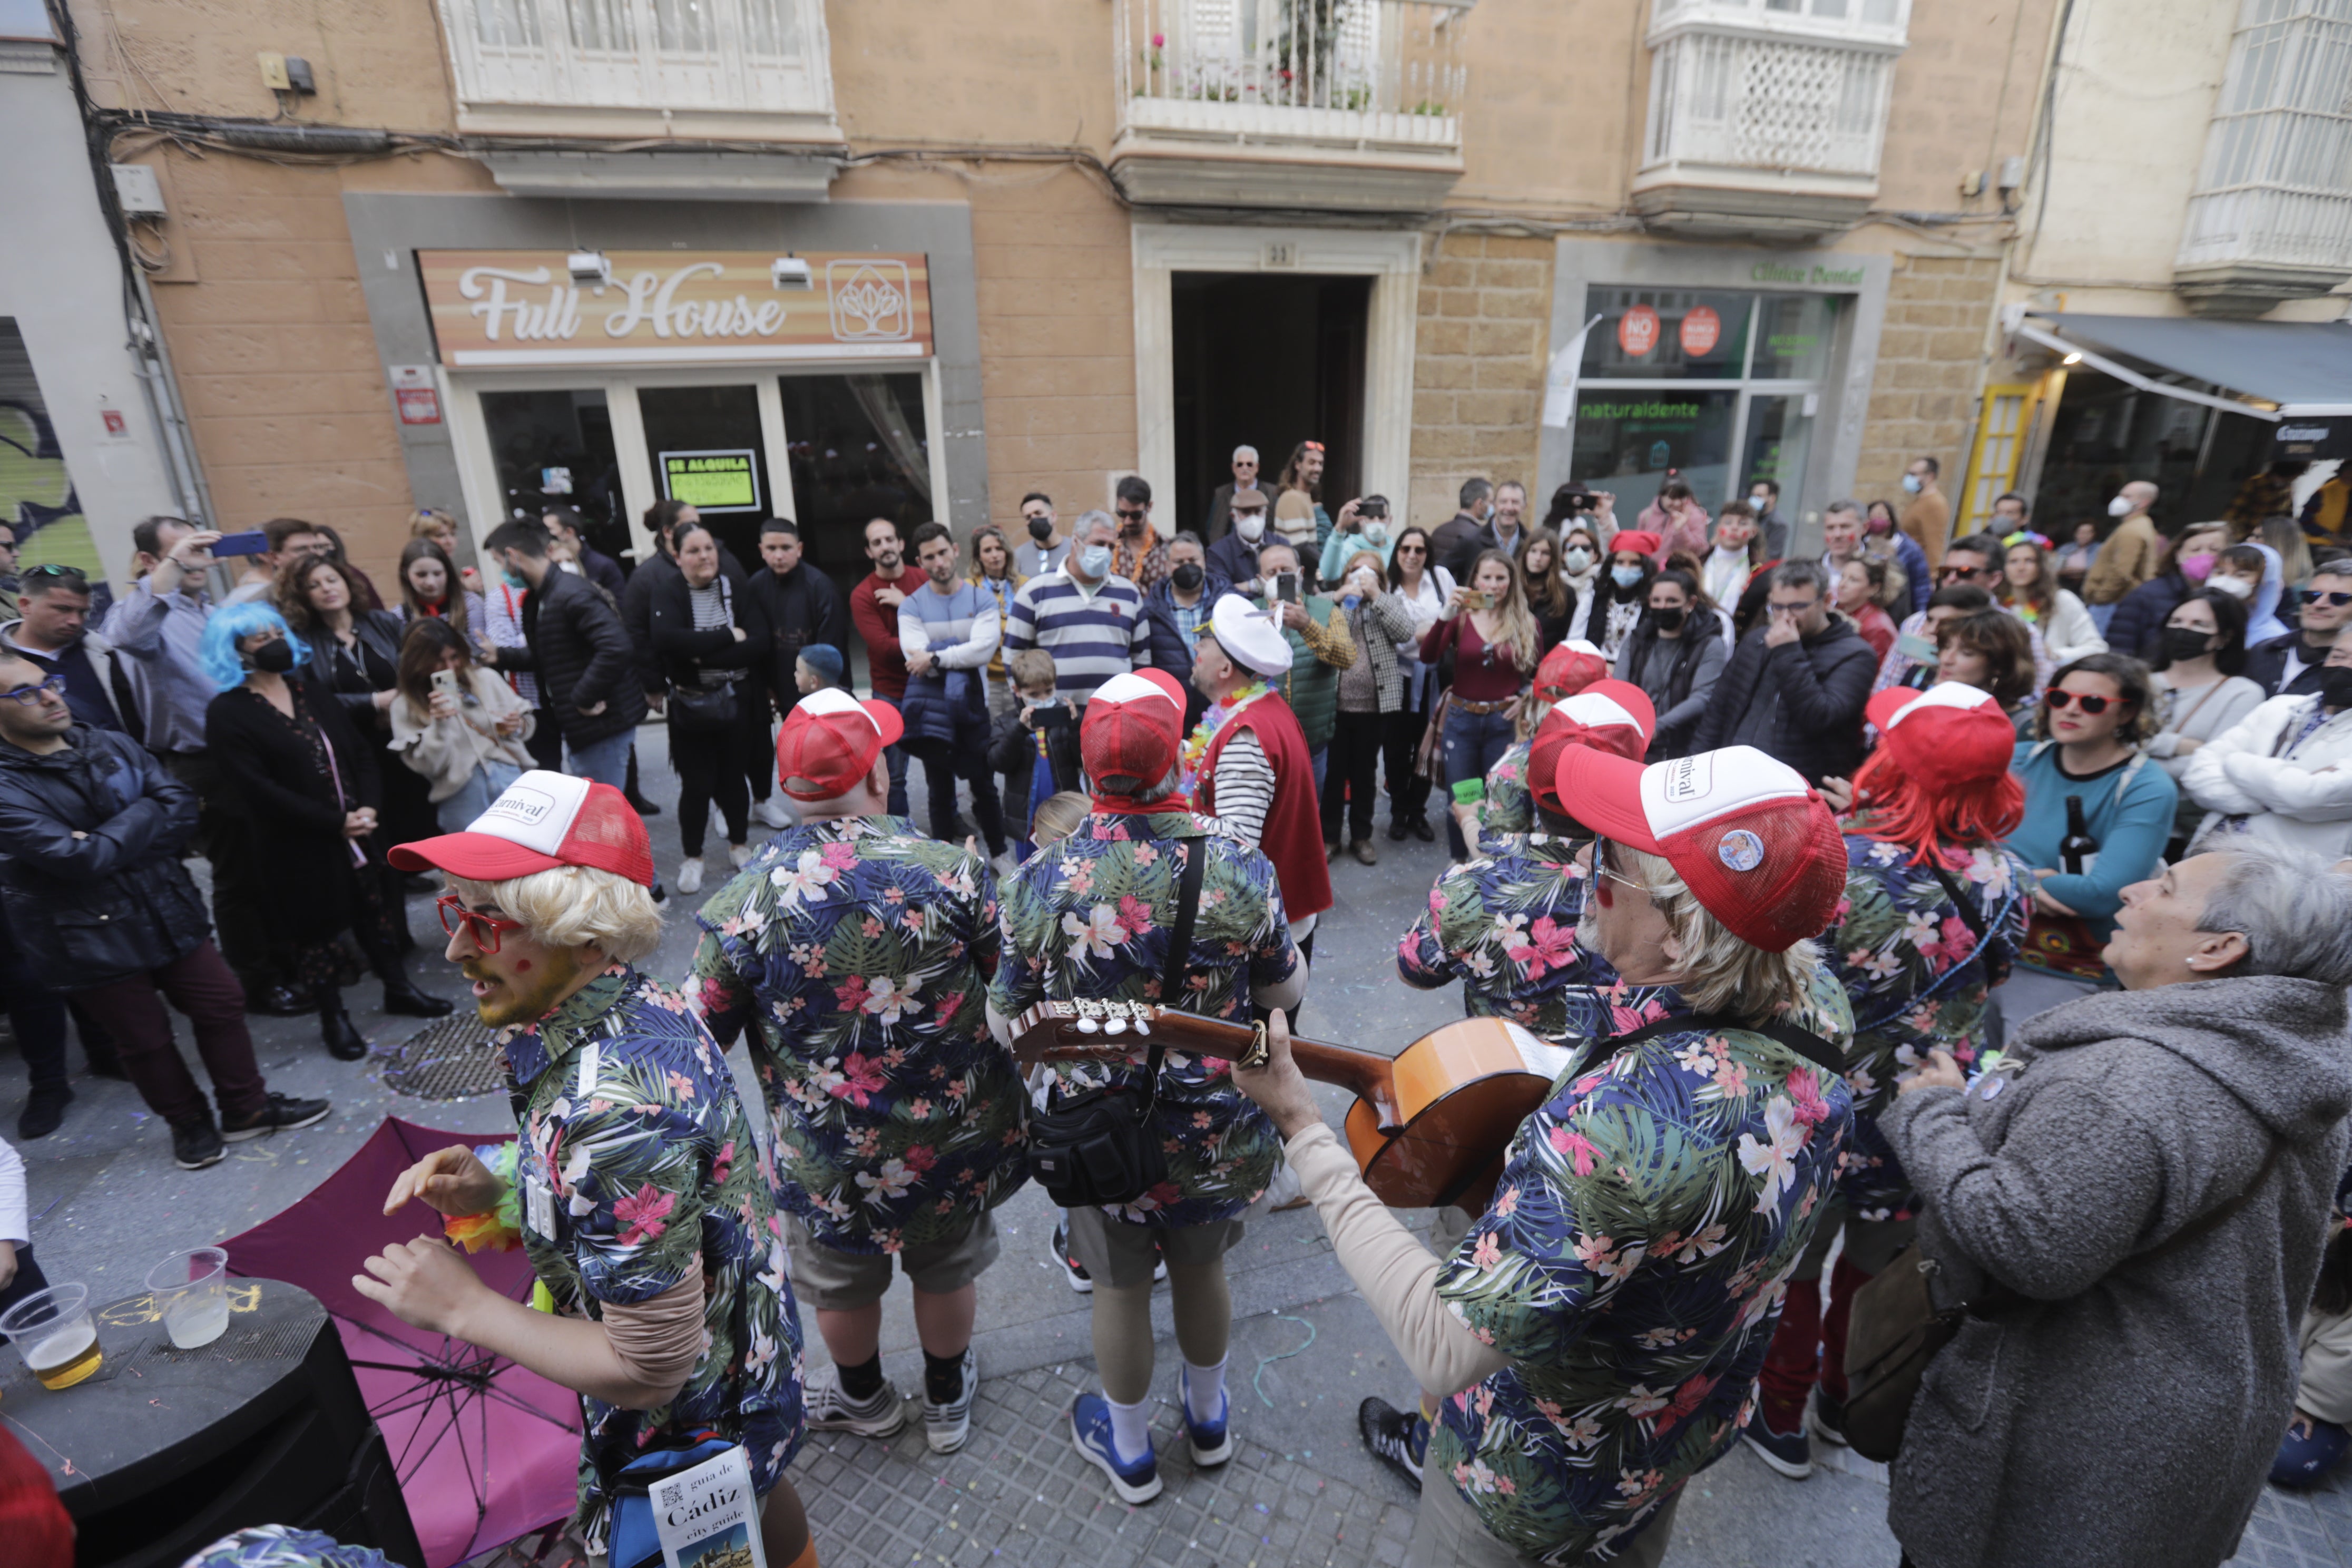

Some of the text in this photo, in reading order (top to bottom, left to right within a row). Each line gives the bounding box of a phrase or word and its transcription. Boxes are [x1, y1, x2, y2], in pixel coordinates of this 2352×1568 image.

[459, 262, 787, 341] Full House
[1625, 317, 1653, 336] NO
[1580, 400, 1700, 418] naturaldente
[668, 457, 750, 473] SE ALQUILA
[494, 799, 544, 817] arnival
[690, 1463, 733, 1492] guía de
[667, 1487, 741, 1527] Cádiz
[687, 1511, 744, 1540] city guide
